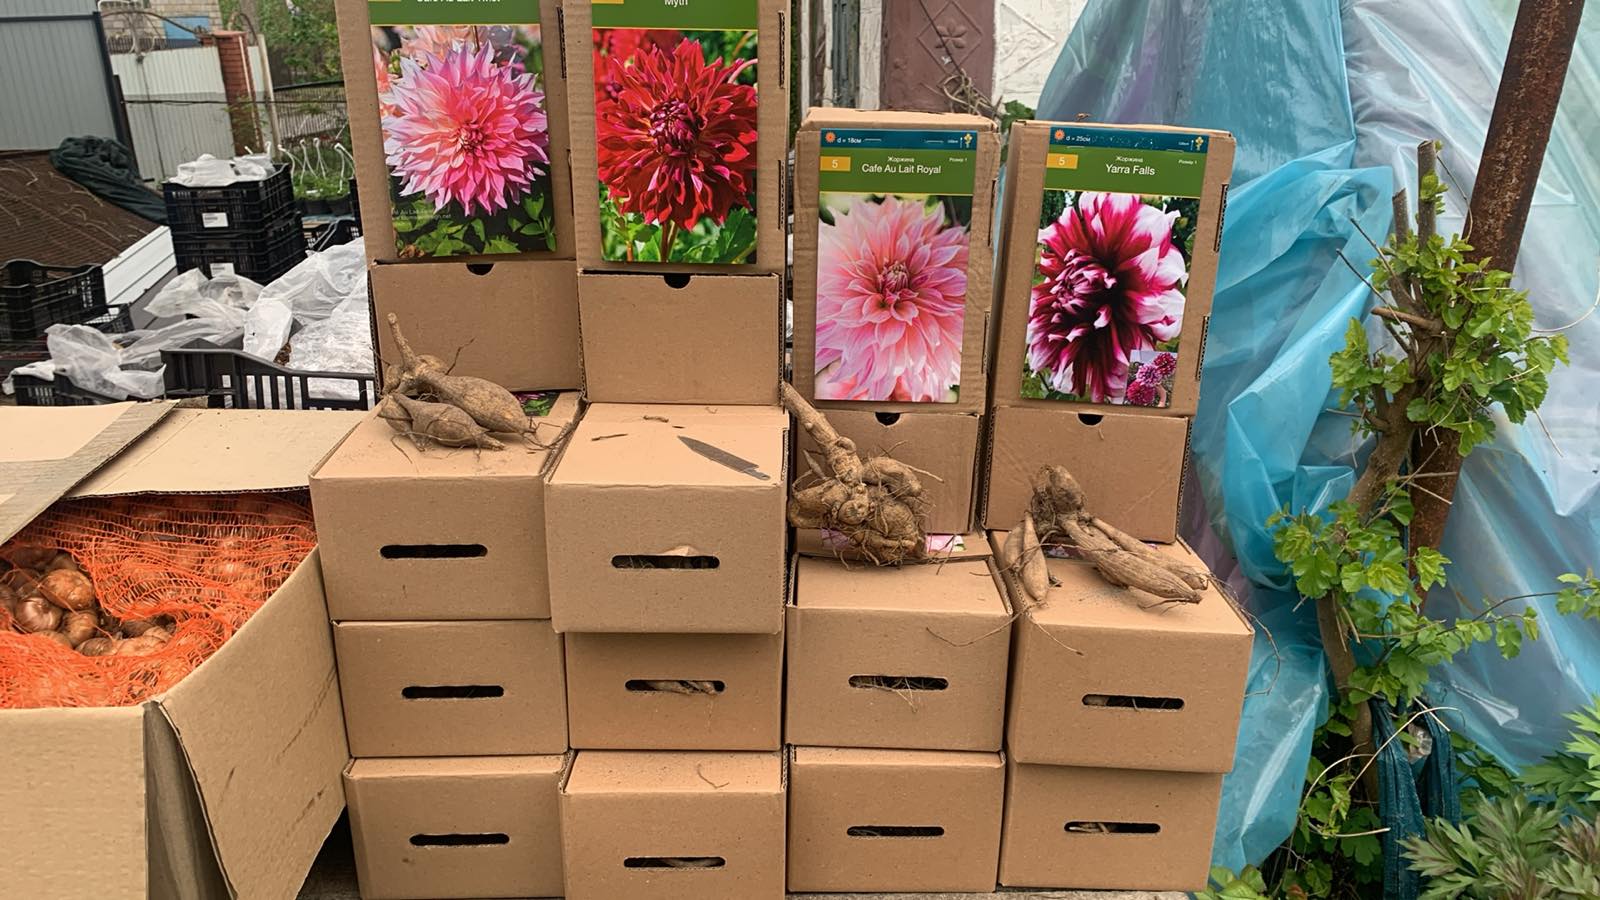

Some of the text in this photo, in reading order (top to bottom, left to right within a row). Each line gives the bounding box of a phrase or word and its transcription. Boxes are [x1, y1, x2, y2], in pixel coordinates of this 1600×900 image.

[832, 160, 838, 169] 5
[1058, 157, 1065, 166] 5
[861, 163, 942, 175] Cafe Au Lait Royal
[1106, 164, 1156, 175] Yarra Falls
